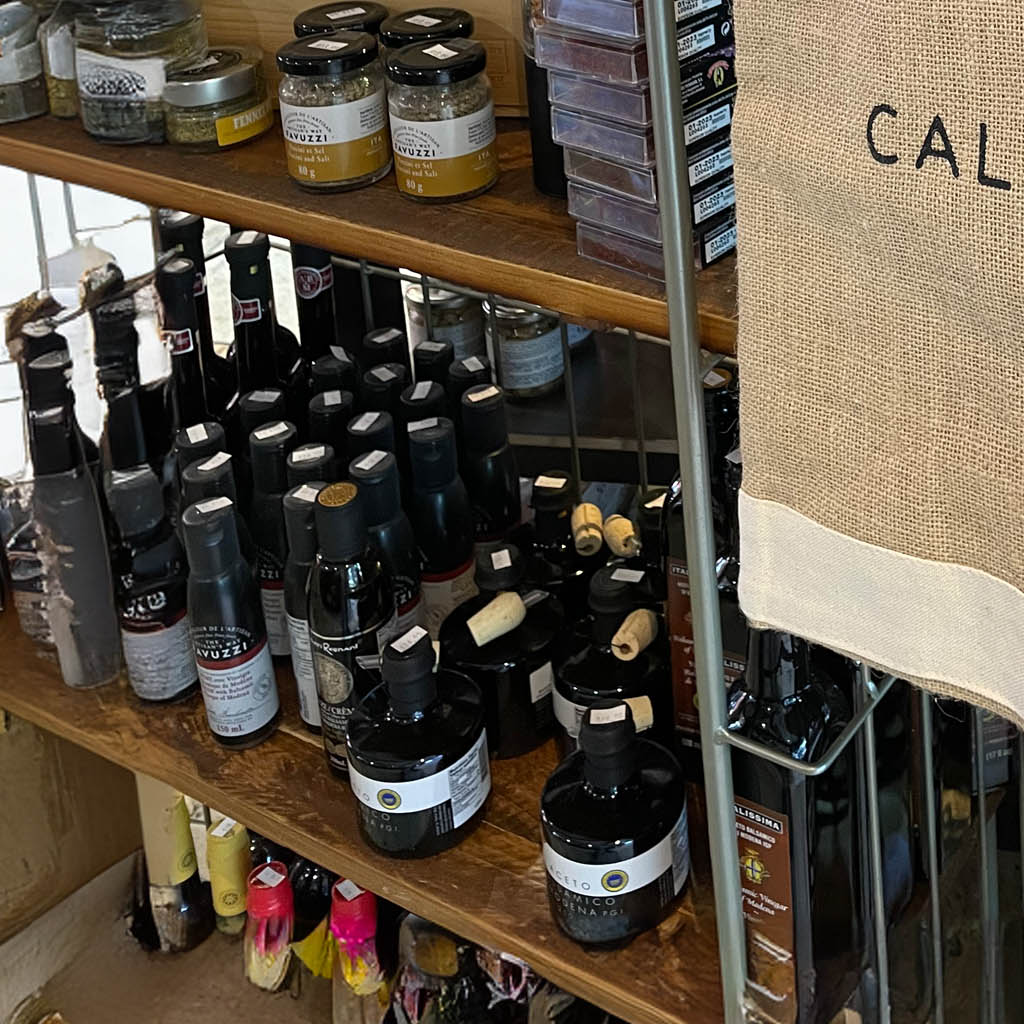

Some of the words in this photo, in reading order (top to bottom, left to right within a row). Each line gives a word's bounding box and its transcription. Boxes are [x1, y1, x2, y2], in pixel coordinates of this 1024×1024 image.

[196, 641, 248, 660] AVUZZI
[734, 803, 780, 832] ALISSIMA
[563, 889, 616, 906] AMICO
